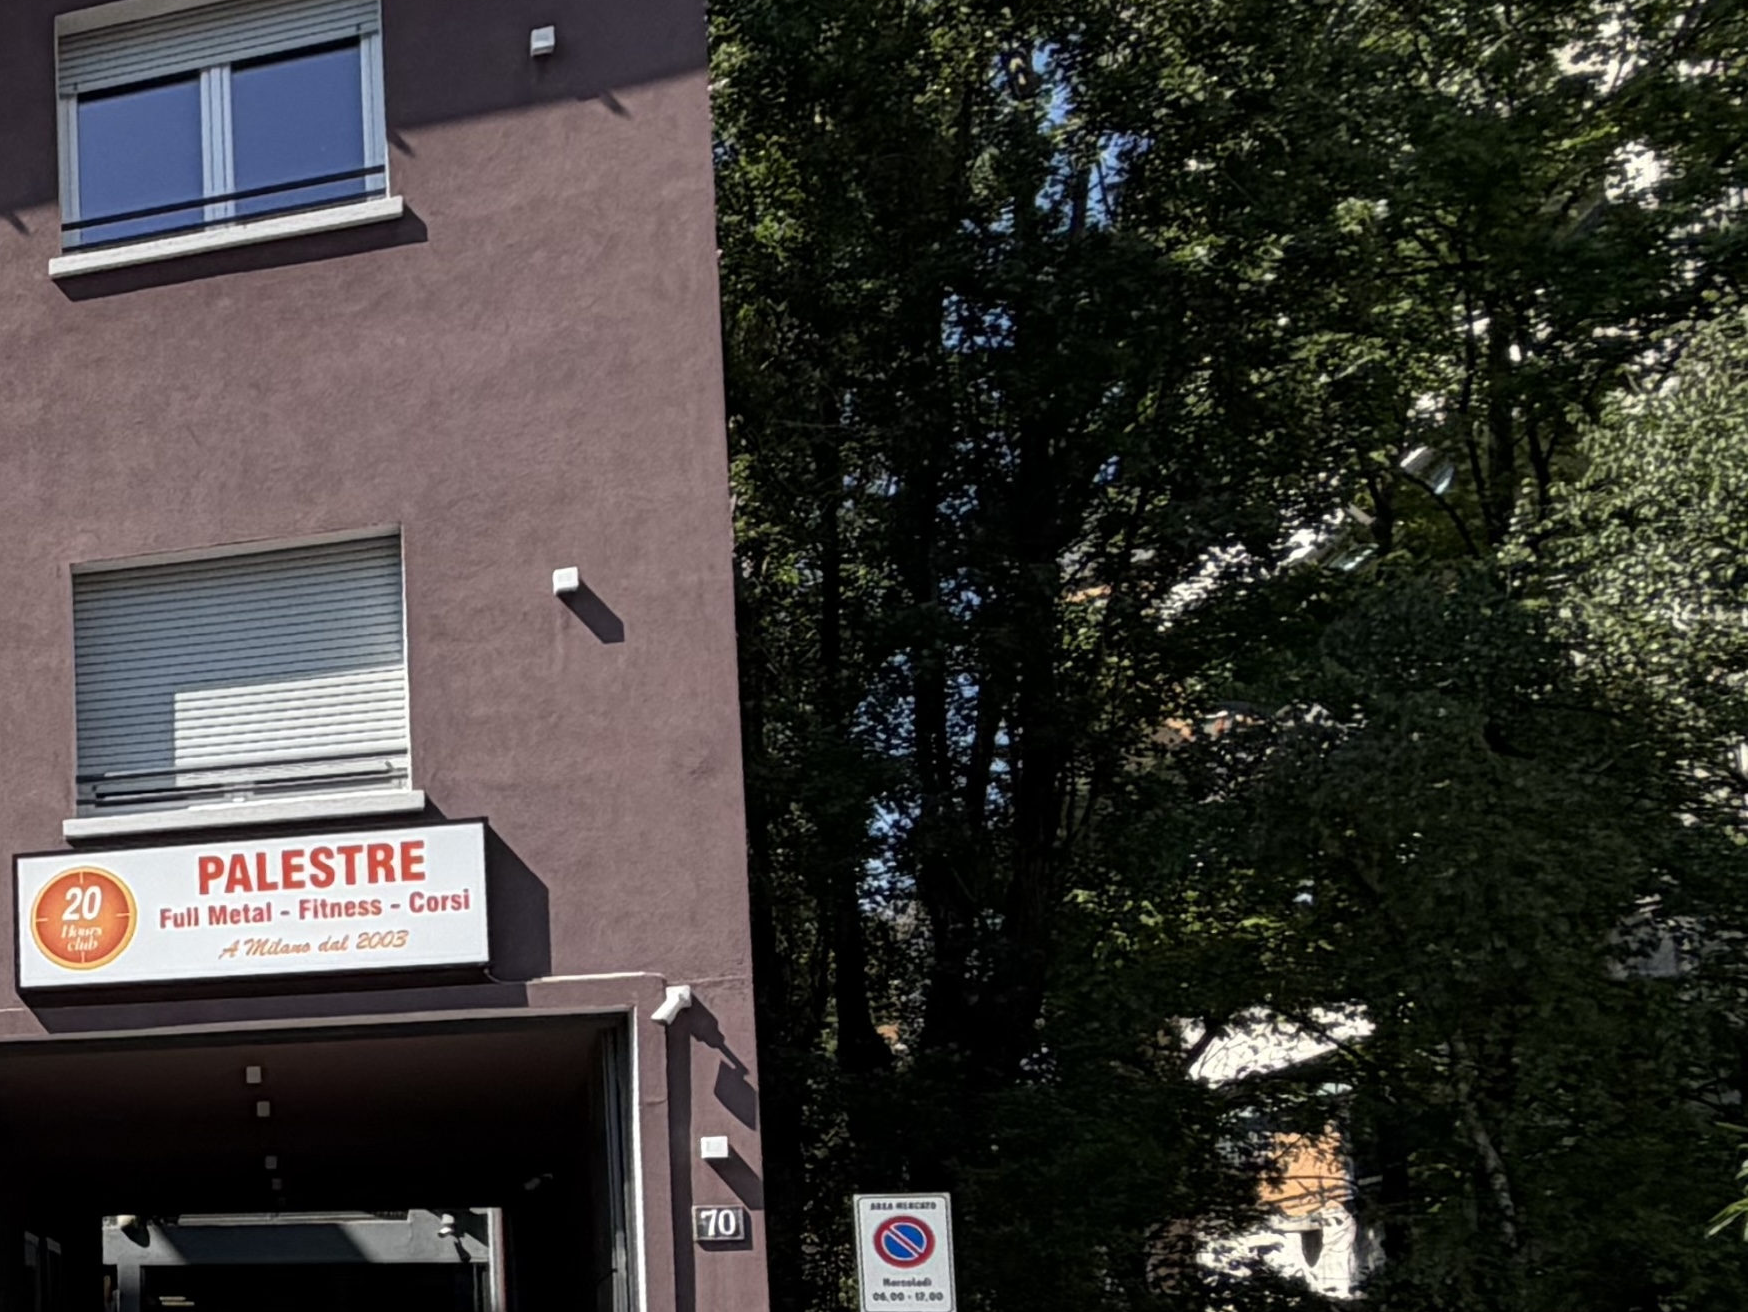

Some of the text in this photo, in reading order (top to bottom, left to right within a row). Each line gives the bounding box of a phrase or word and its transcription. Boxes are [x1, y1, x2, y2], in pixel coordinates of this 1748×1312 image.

[198, 840, 426, 895] PALESTRE
[61, 885, 102, 921] 20
[159, 906, 200, 929] Full
[208, 902, 272, 926] Metal
[299, 897, 383, 920] Fitness
[409, 888, 470, 914] Corsi
[66, 936, 99, 952] club
[218, 929, 410, 960] A Milano dal 2003
[700, 1209, 736, 1236] 70
